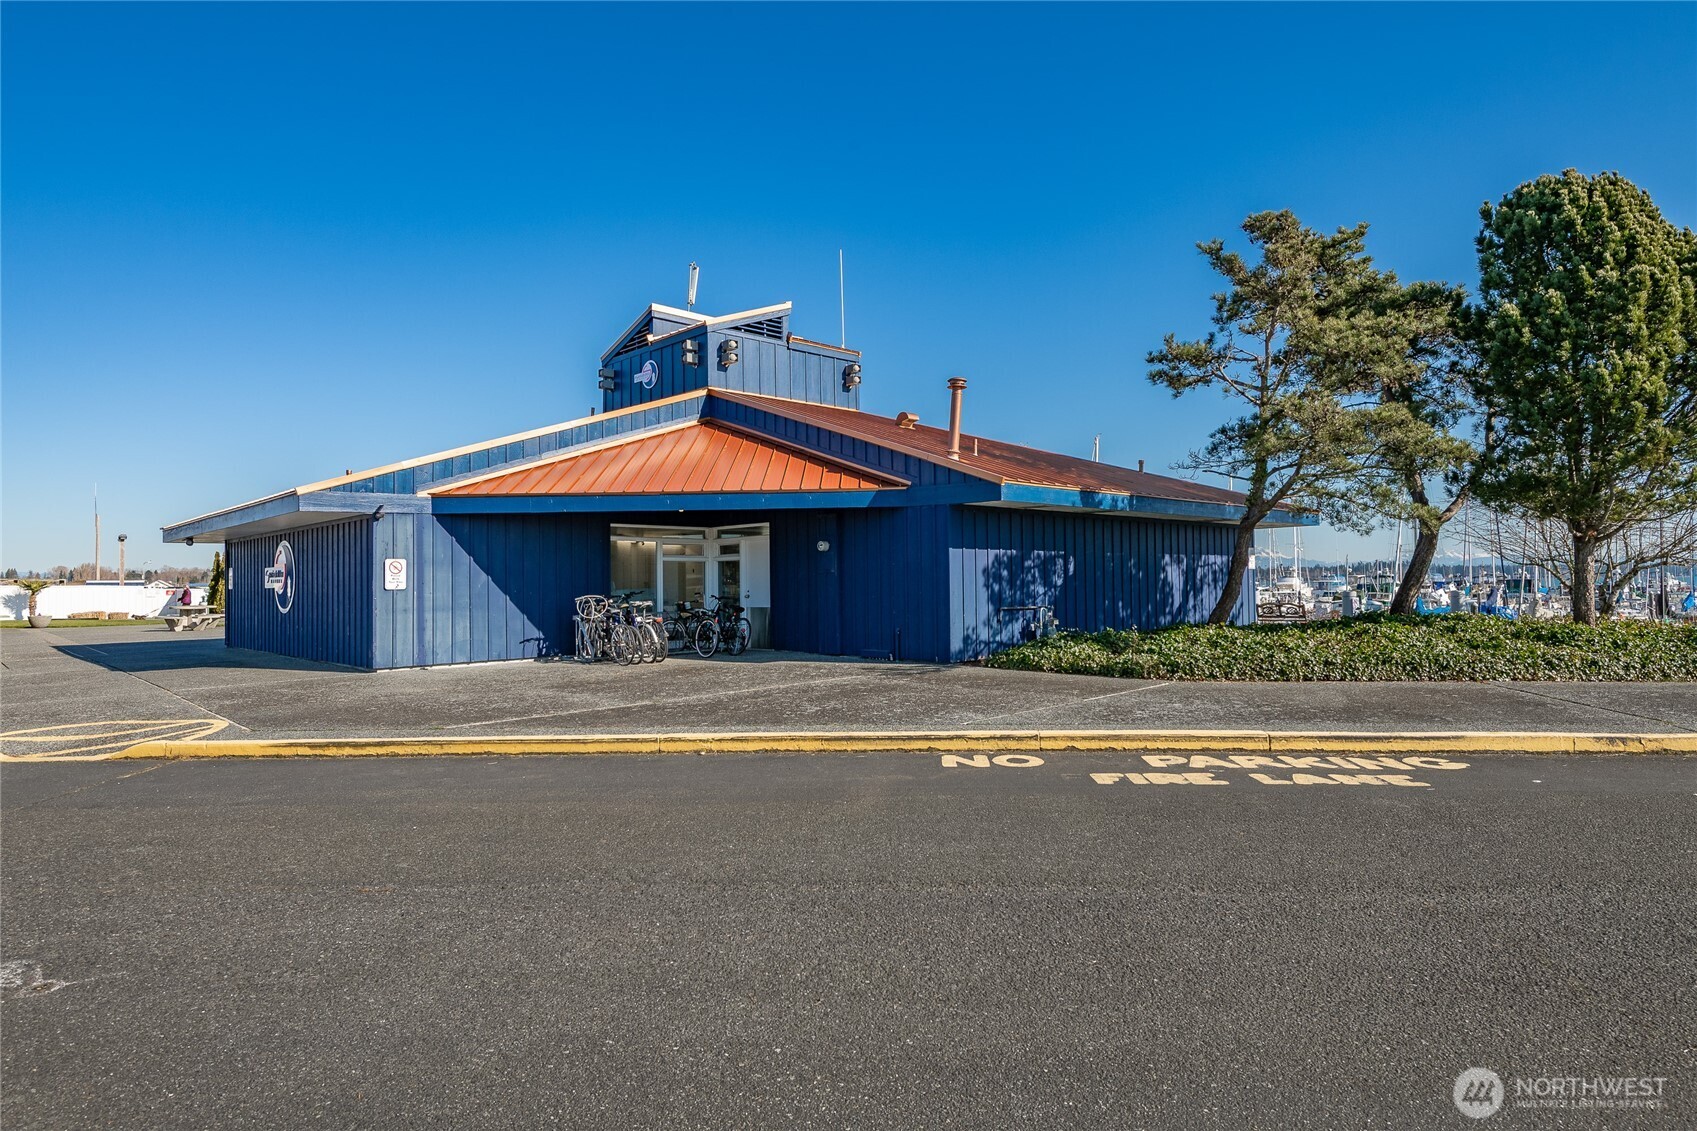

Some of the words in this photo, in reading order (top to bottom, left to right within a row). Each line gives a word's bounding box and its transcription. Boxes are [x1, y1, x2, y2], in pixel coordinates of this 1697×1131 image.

[941, 754, 1044, 768] NO
[1141, 755, 1471, 770] PARKING
[1089, 772, 1230, 785] FIRE
[1248, 773, 1432, 787] LANE
